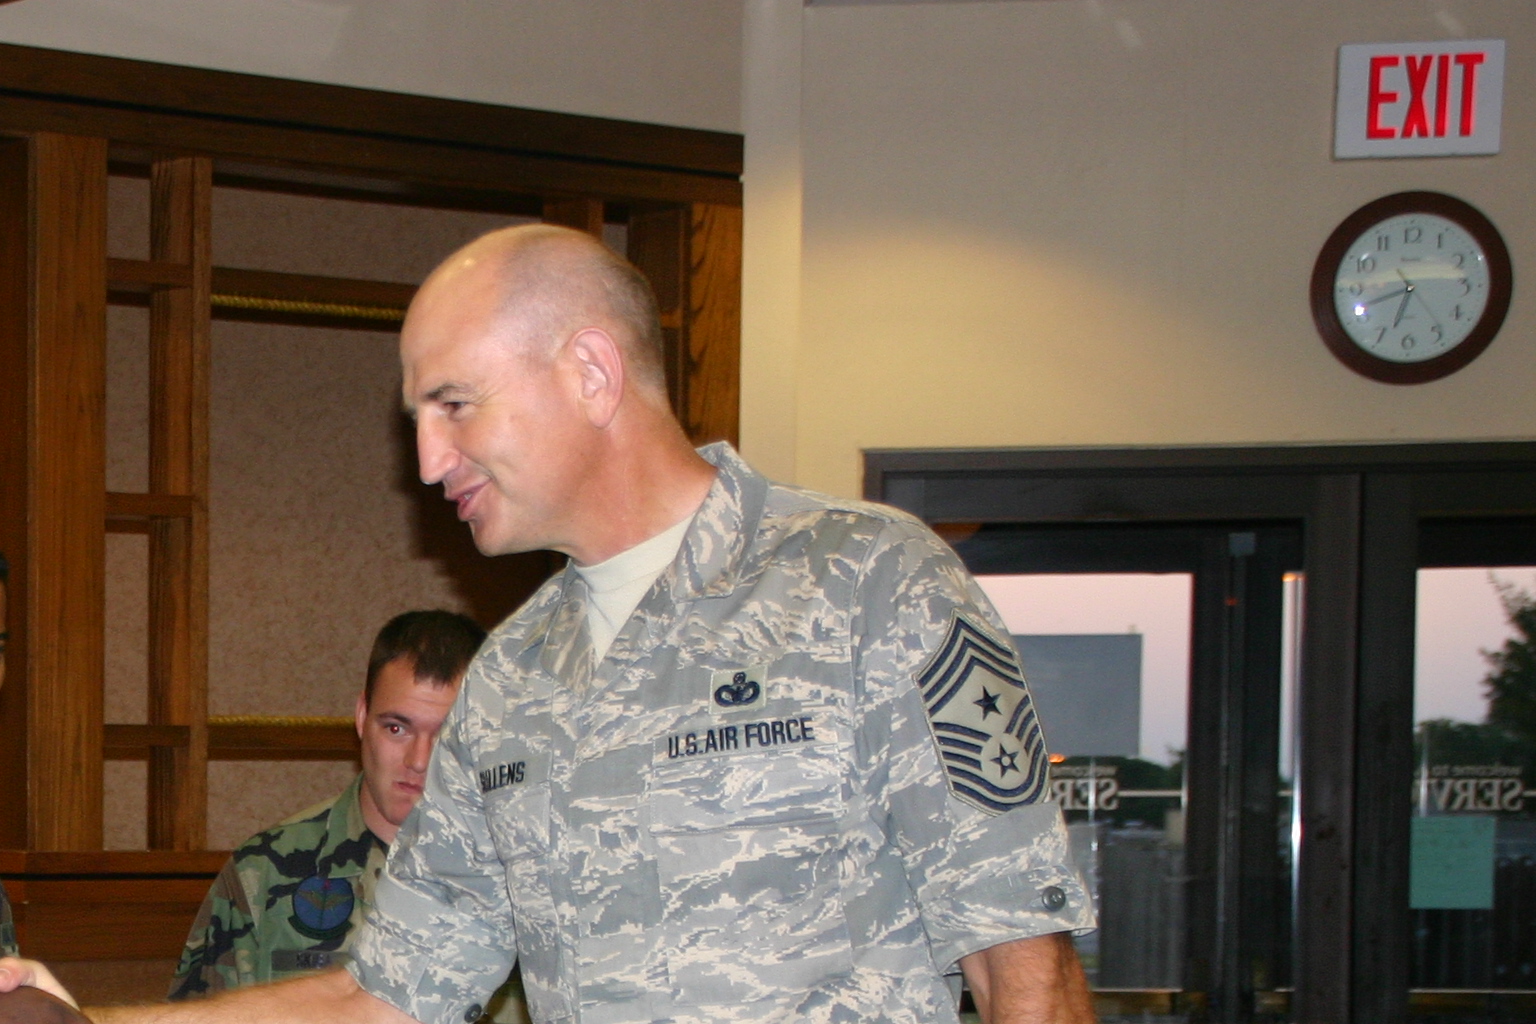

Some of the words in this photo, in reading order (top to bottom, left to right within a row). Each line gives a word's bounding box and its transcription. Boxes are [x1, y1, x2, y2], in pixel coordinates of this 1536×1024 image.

[1366, 52, 1486, 139] EXIT
[1377, 236, 1389, 251] 11
[1404, 227, 1422, 244] 12
[1437, 233, 1443, 248] 1
[1357, 257, 1375, 273] 10
[1452, 254, 1463, 269] 2
[1458, 278, 1470, 297] 3
[1450, 305, 1462, 320] 4
[1375, 327, 1387, 344] 7
[1401, 334, 1414, 349] 6
[1431, 324, 1442, 343] 5
[744, 717, 816, 748] FORCE
